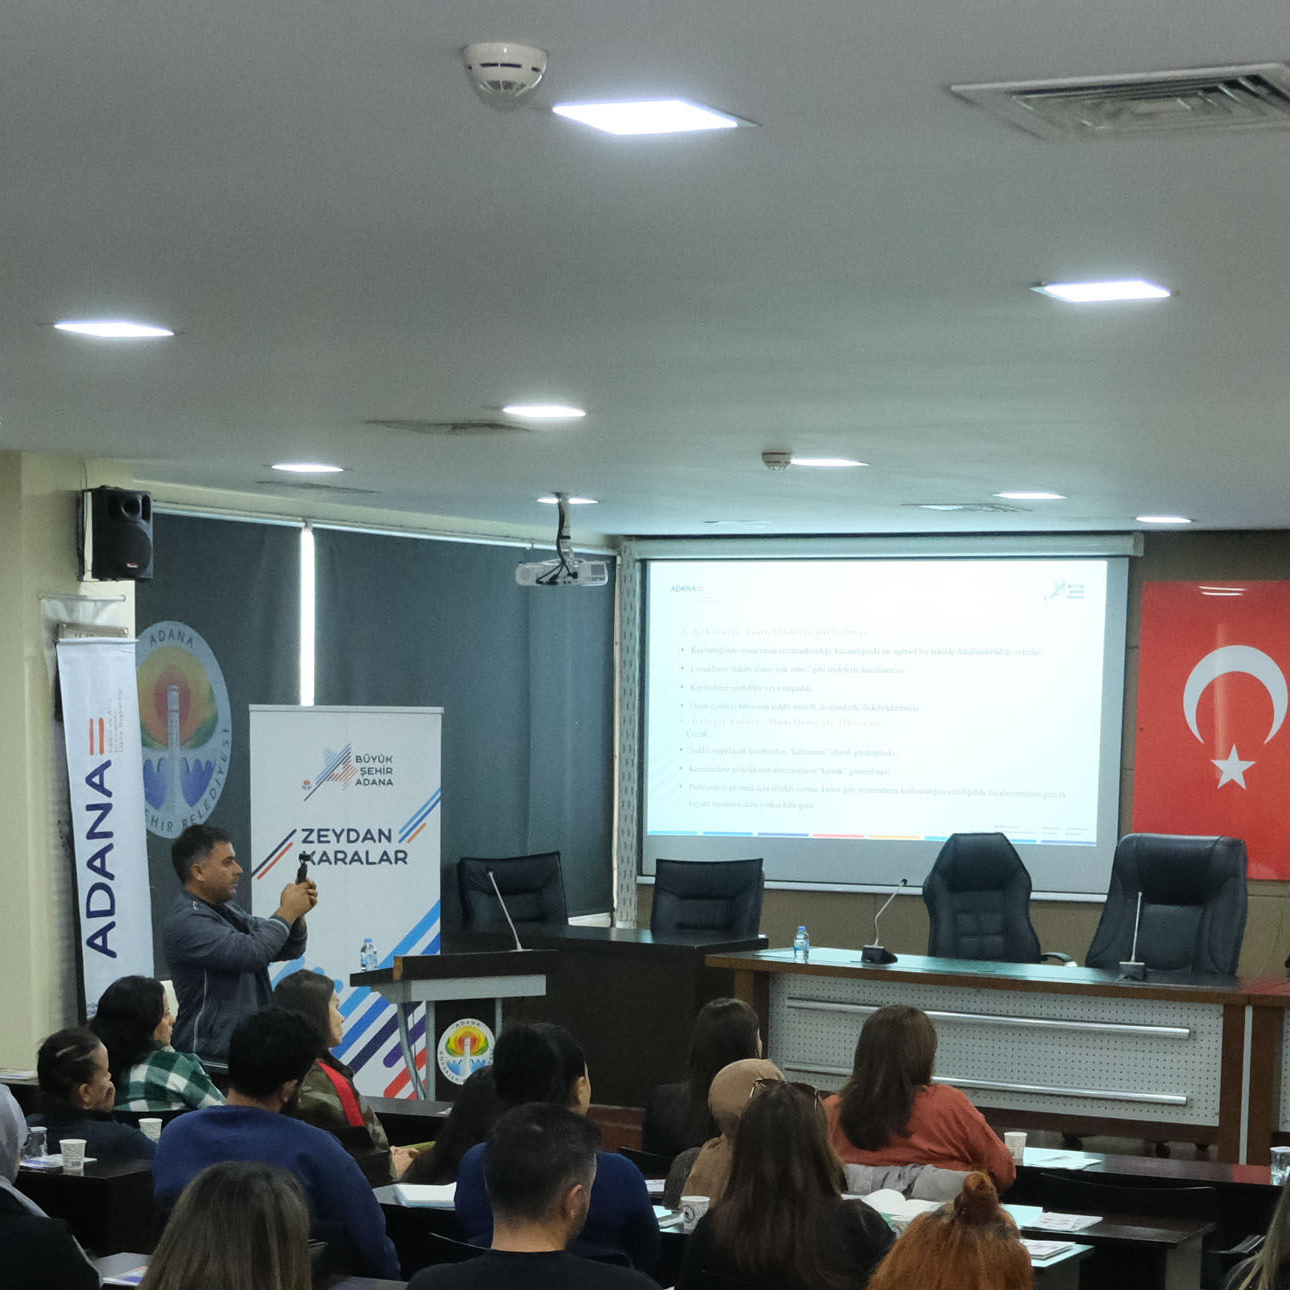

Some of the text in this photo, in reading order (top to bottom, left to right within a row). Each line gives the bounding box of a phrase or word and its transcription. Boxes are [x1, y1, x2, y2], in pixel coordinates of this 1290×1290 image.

[149, 628, 194, 649] ADANA
[355, 754, 393, 763] BÜYÜK
[360, 765, 393, 777] ŞEHİR
[301, 828, 392, 844] ZEYDAN
[85, 760, 117, 958] ADANA
[303, 850, 408, 865] KARALAR
